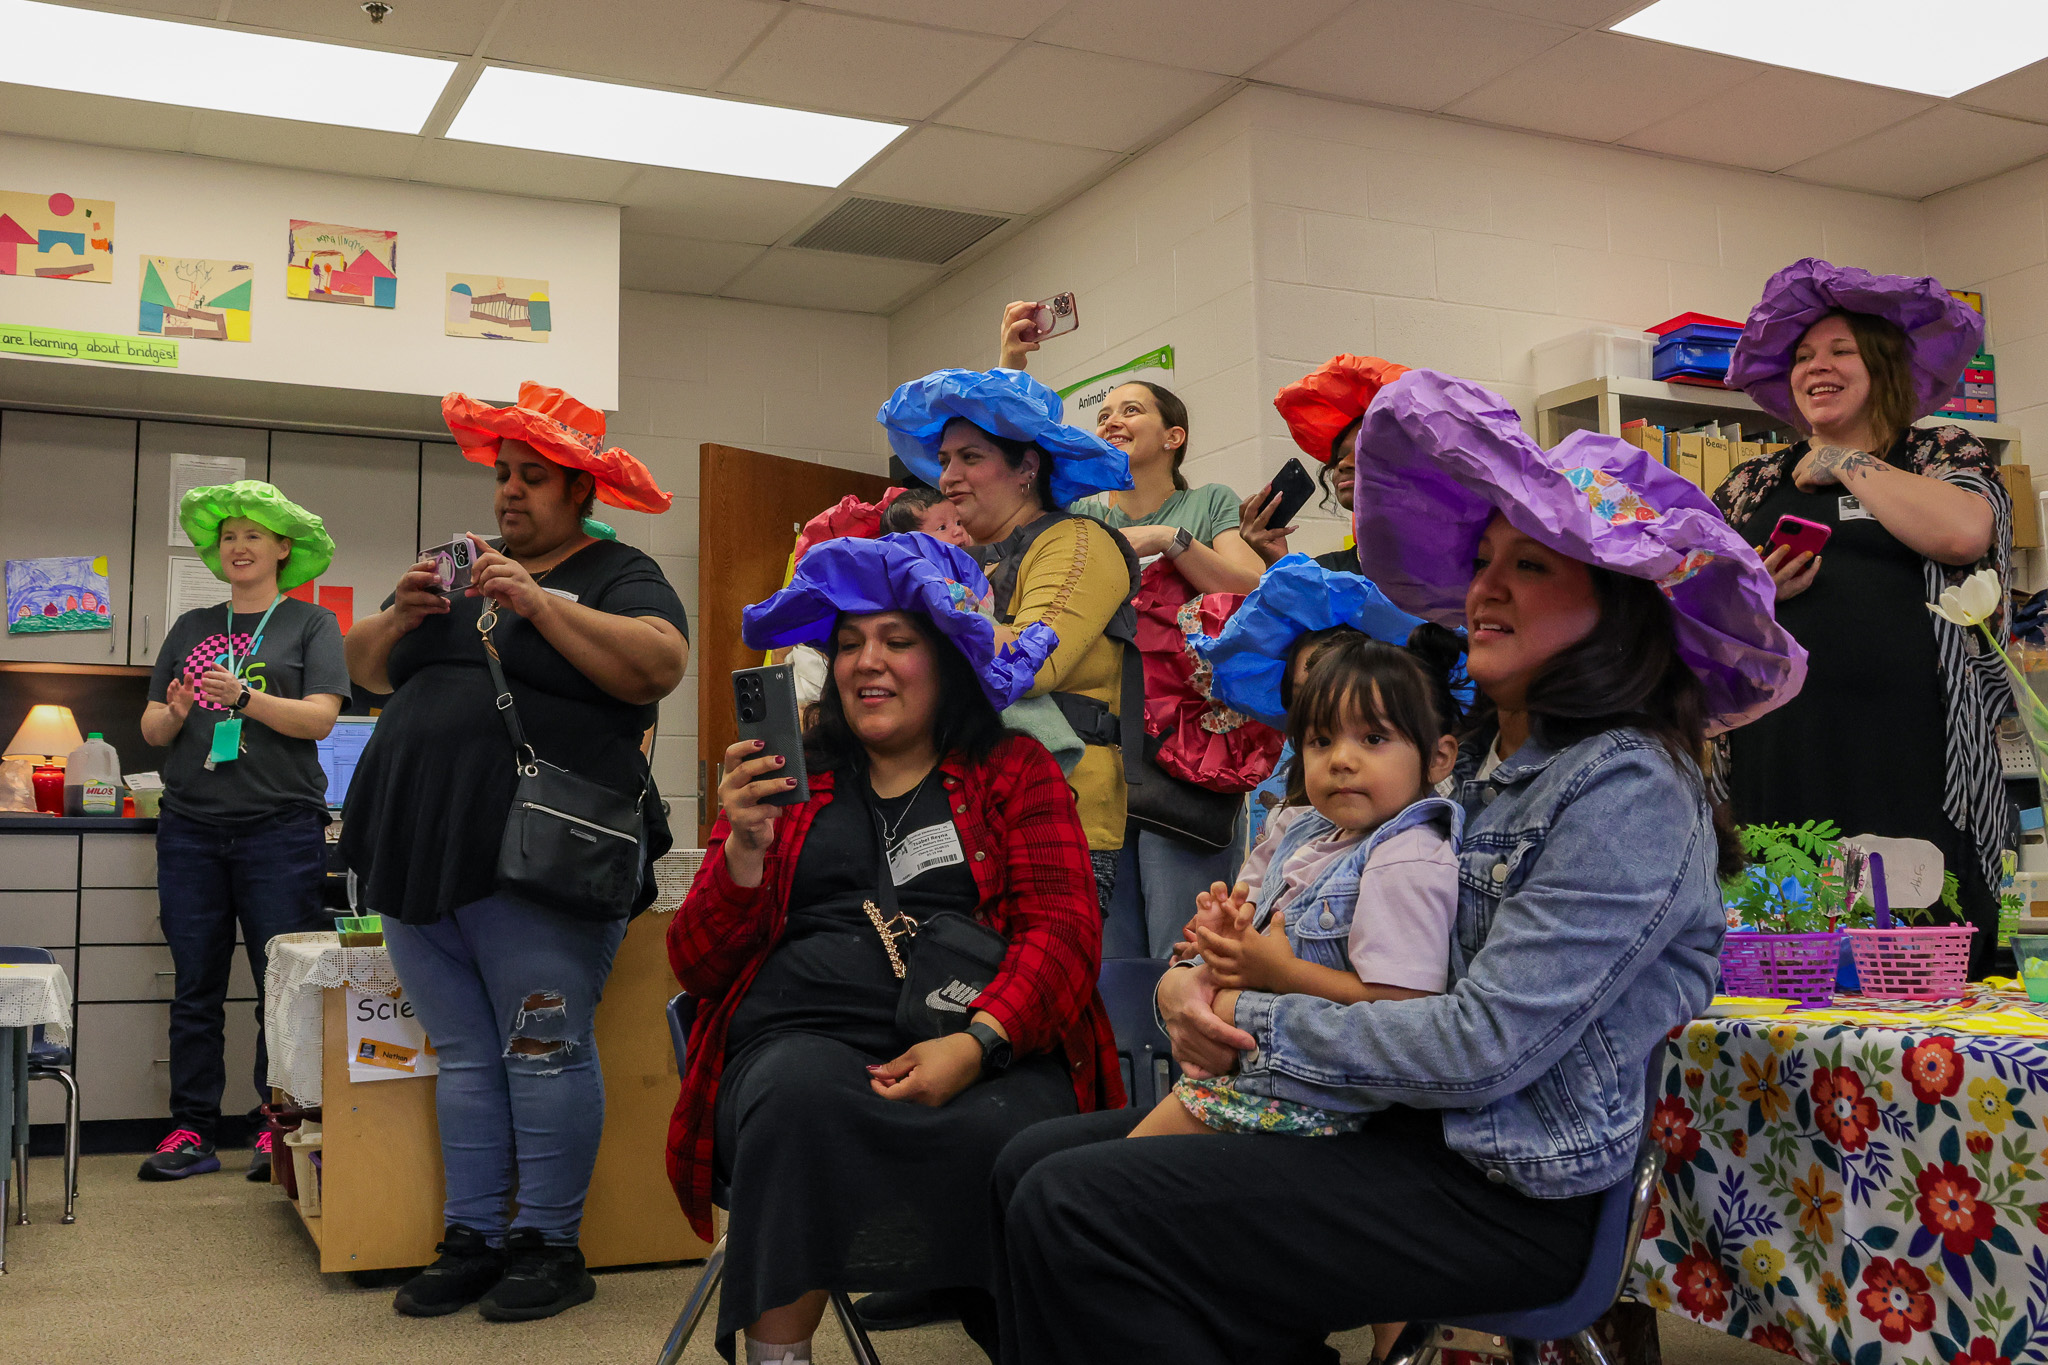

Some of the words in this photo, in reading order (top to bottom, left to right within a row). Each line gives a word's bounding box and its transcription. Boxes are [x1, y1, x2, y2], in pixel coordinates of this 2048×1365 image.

[2, 335, 24, 345] are
[29, 331, 79, 356] learning
[86, 339, 120, 354] about
[127, 341, 177, 363] bridges!
[1078, 388, 1107, 410] Animals
[1705, 437, 1728, 451] Bears
[382, 1051, 408, 1062] Nathan
